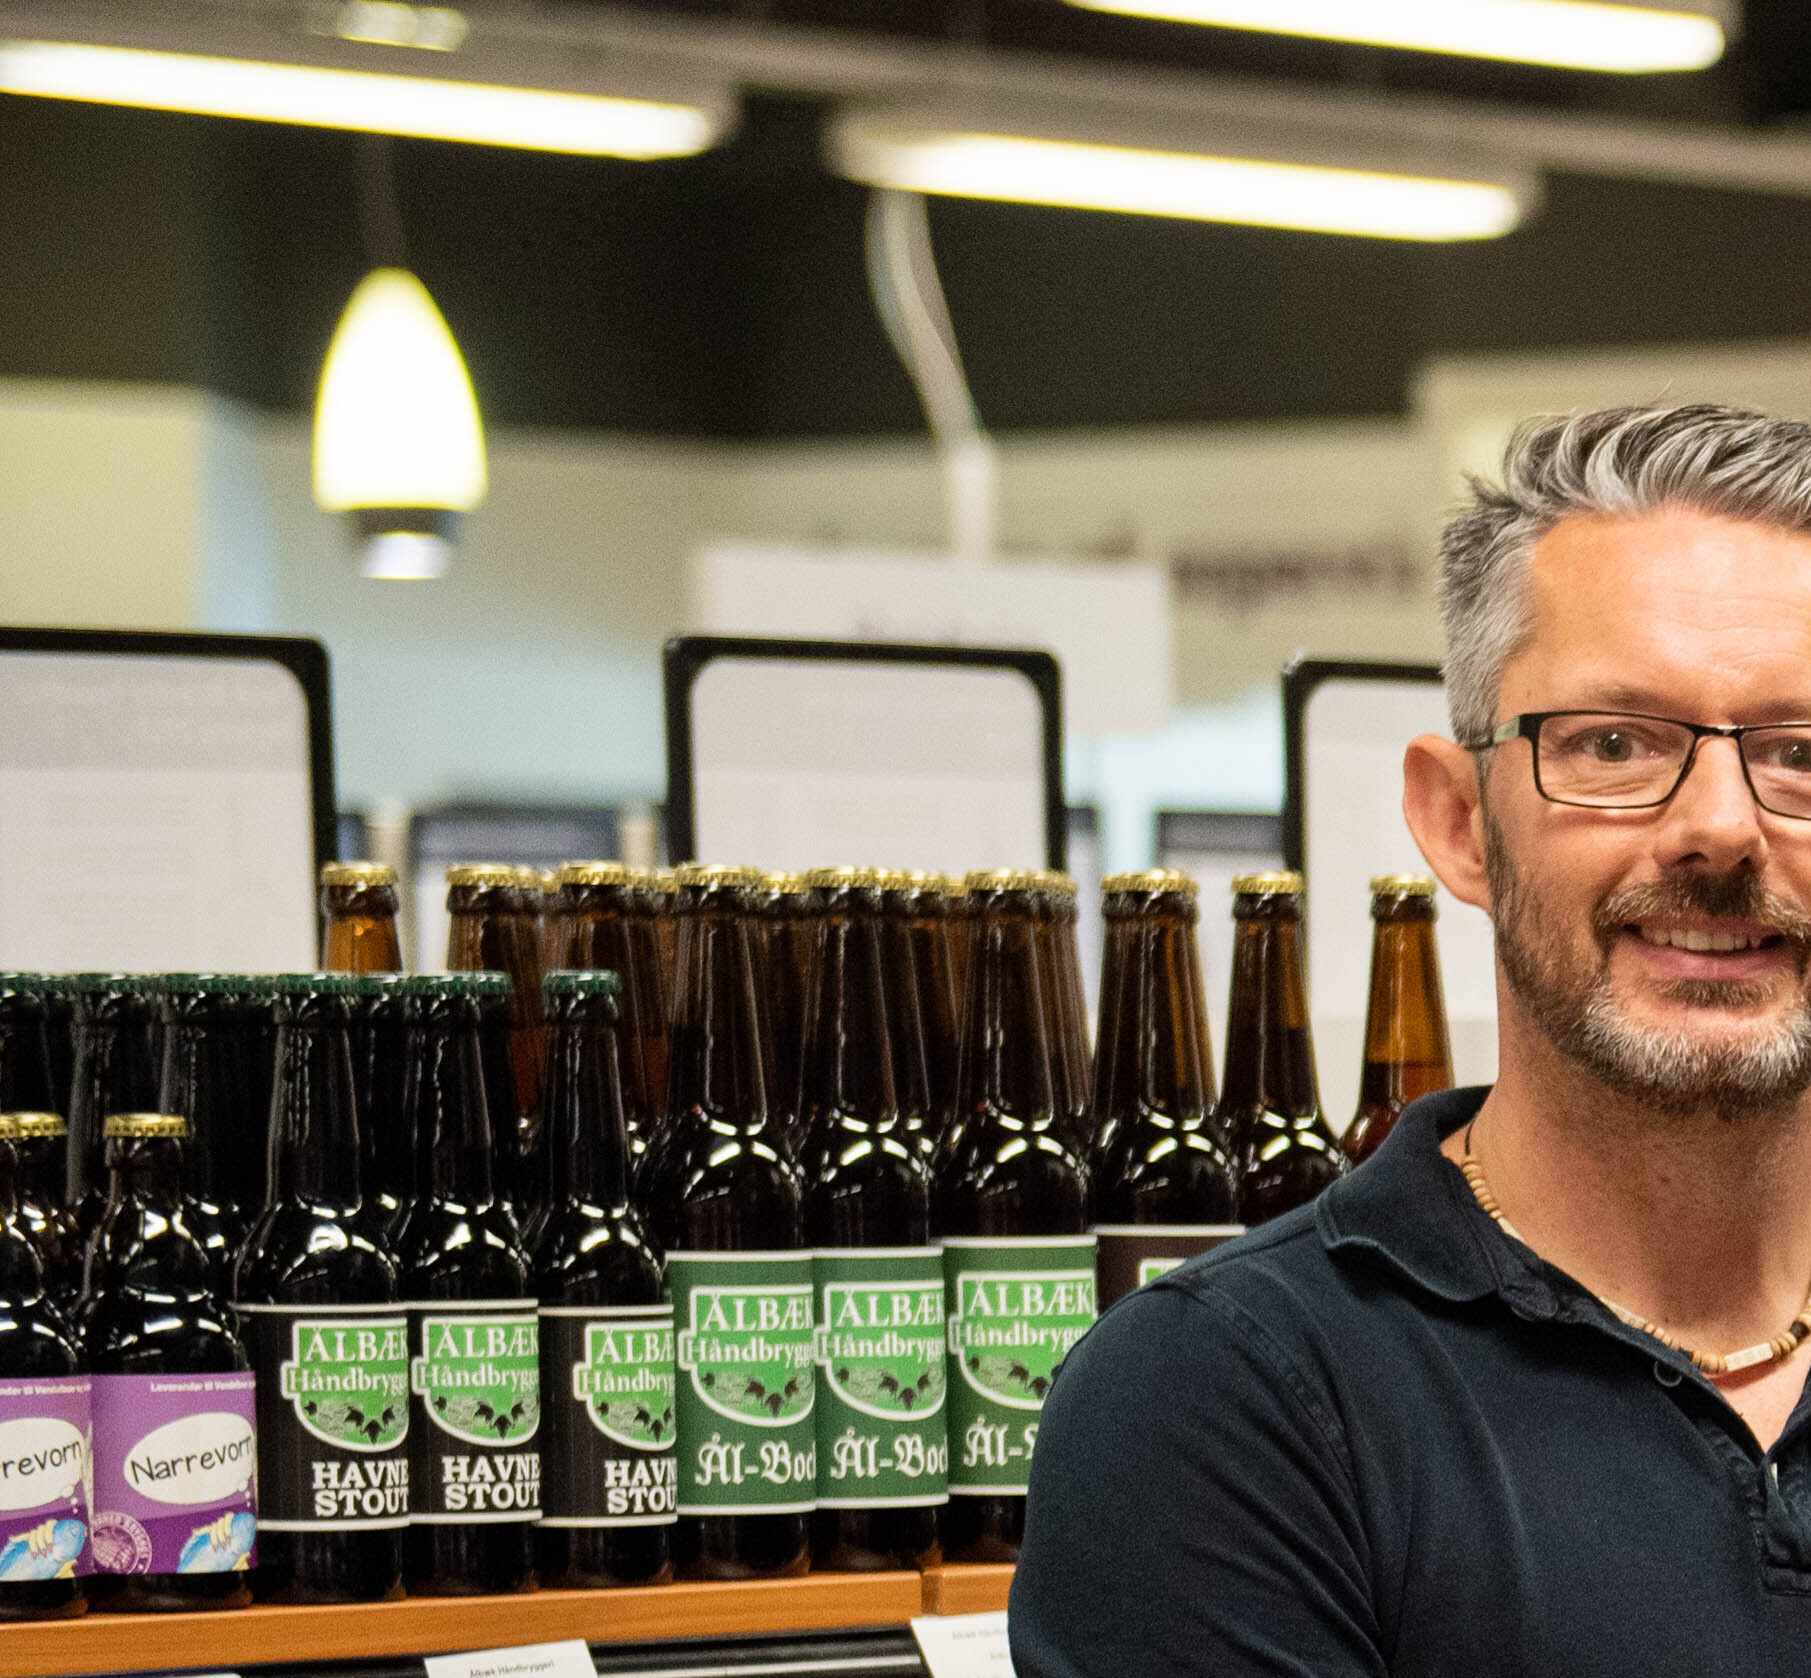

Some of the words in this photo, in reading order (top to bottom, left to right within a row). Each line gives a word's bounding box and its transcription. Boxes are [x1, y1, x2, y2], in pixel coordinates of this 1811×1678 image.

[969, 1280, 1095, 1317] ÅLBÆK
[312, 1459, 408, 1489] HAVNE
[442, 1453, 541, 1483] HAVNE
[314, 1488, 408, 1517] STOUT
[444, 1481, 541, 1512] STOUT
